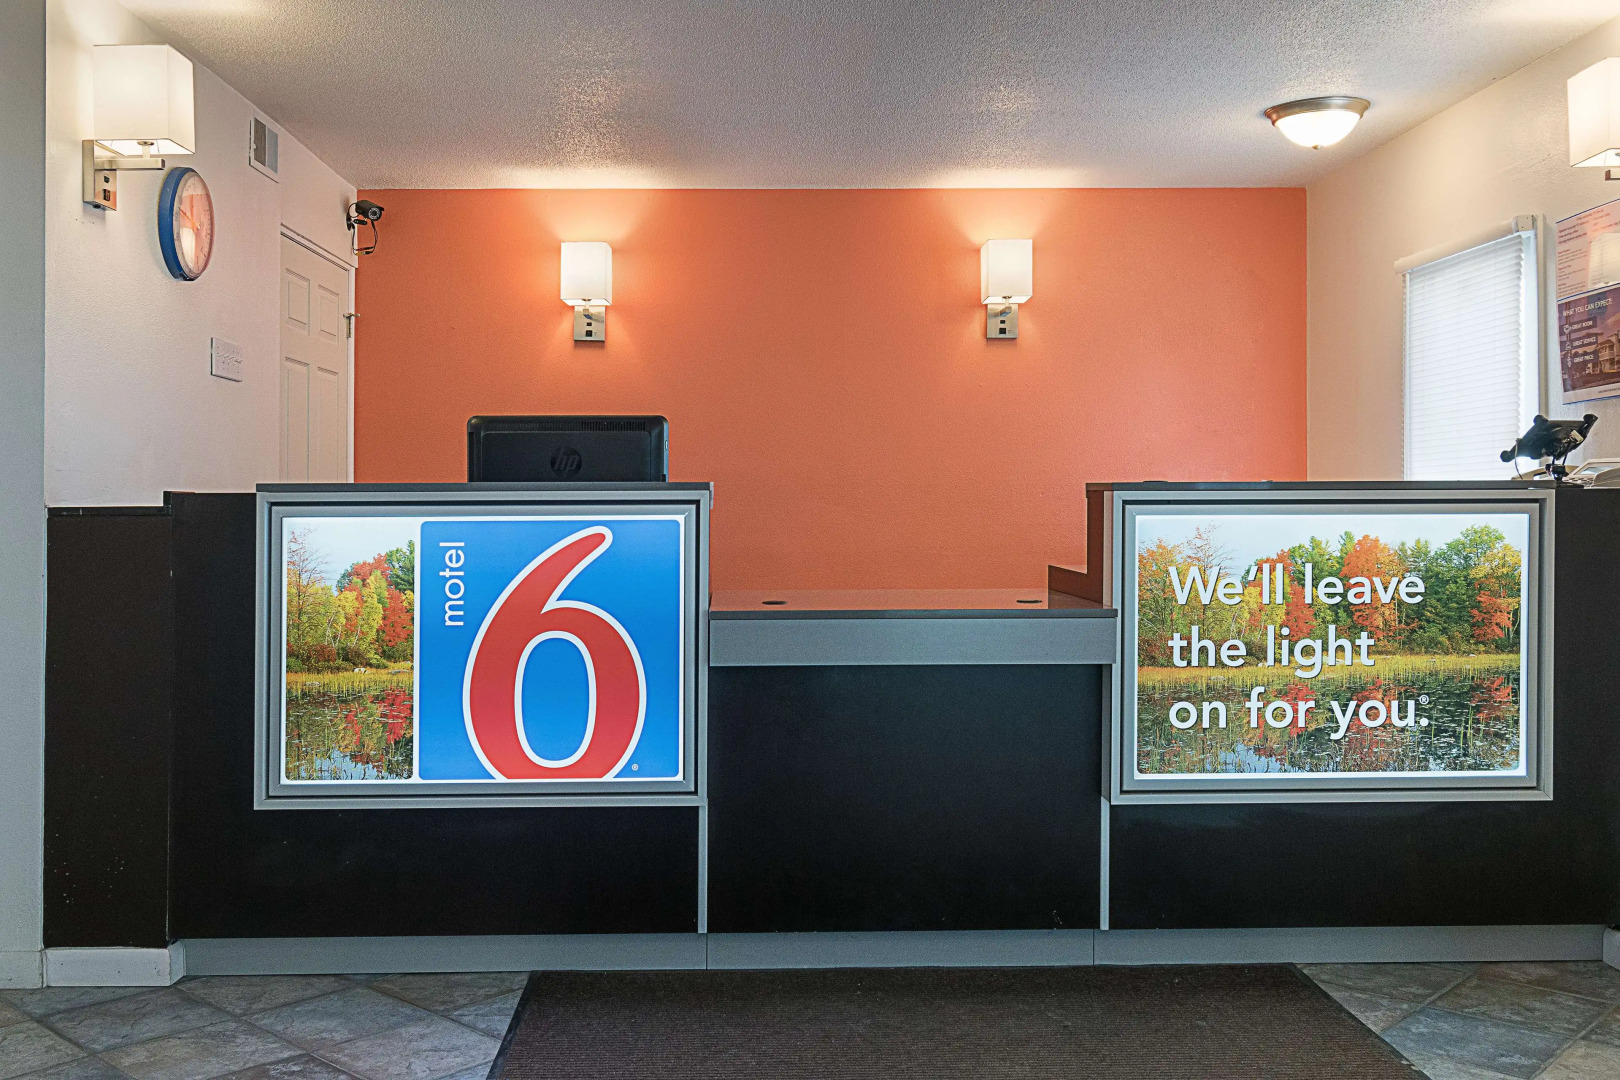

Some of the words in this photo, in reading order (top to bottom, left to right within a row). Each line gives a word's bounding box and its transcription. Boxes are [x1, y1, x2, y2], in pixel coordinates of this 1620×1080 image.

[553, 447, 581, 478] hp
[439, 541, 465, 627] motel
[1168, 562, 1284, 605] We'll
[1304, 562, 1426, 605] leave
[463, 525, 647, 780] 6
[1168, 624, 1247, 668] the
[1267, 623, 1376, 679] light
[1168, 700, 1227, 729] on
[1245, 686, 1315, 729] for
